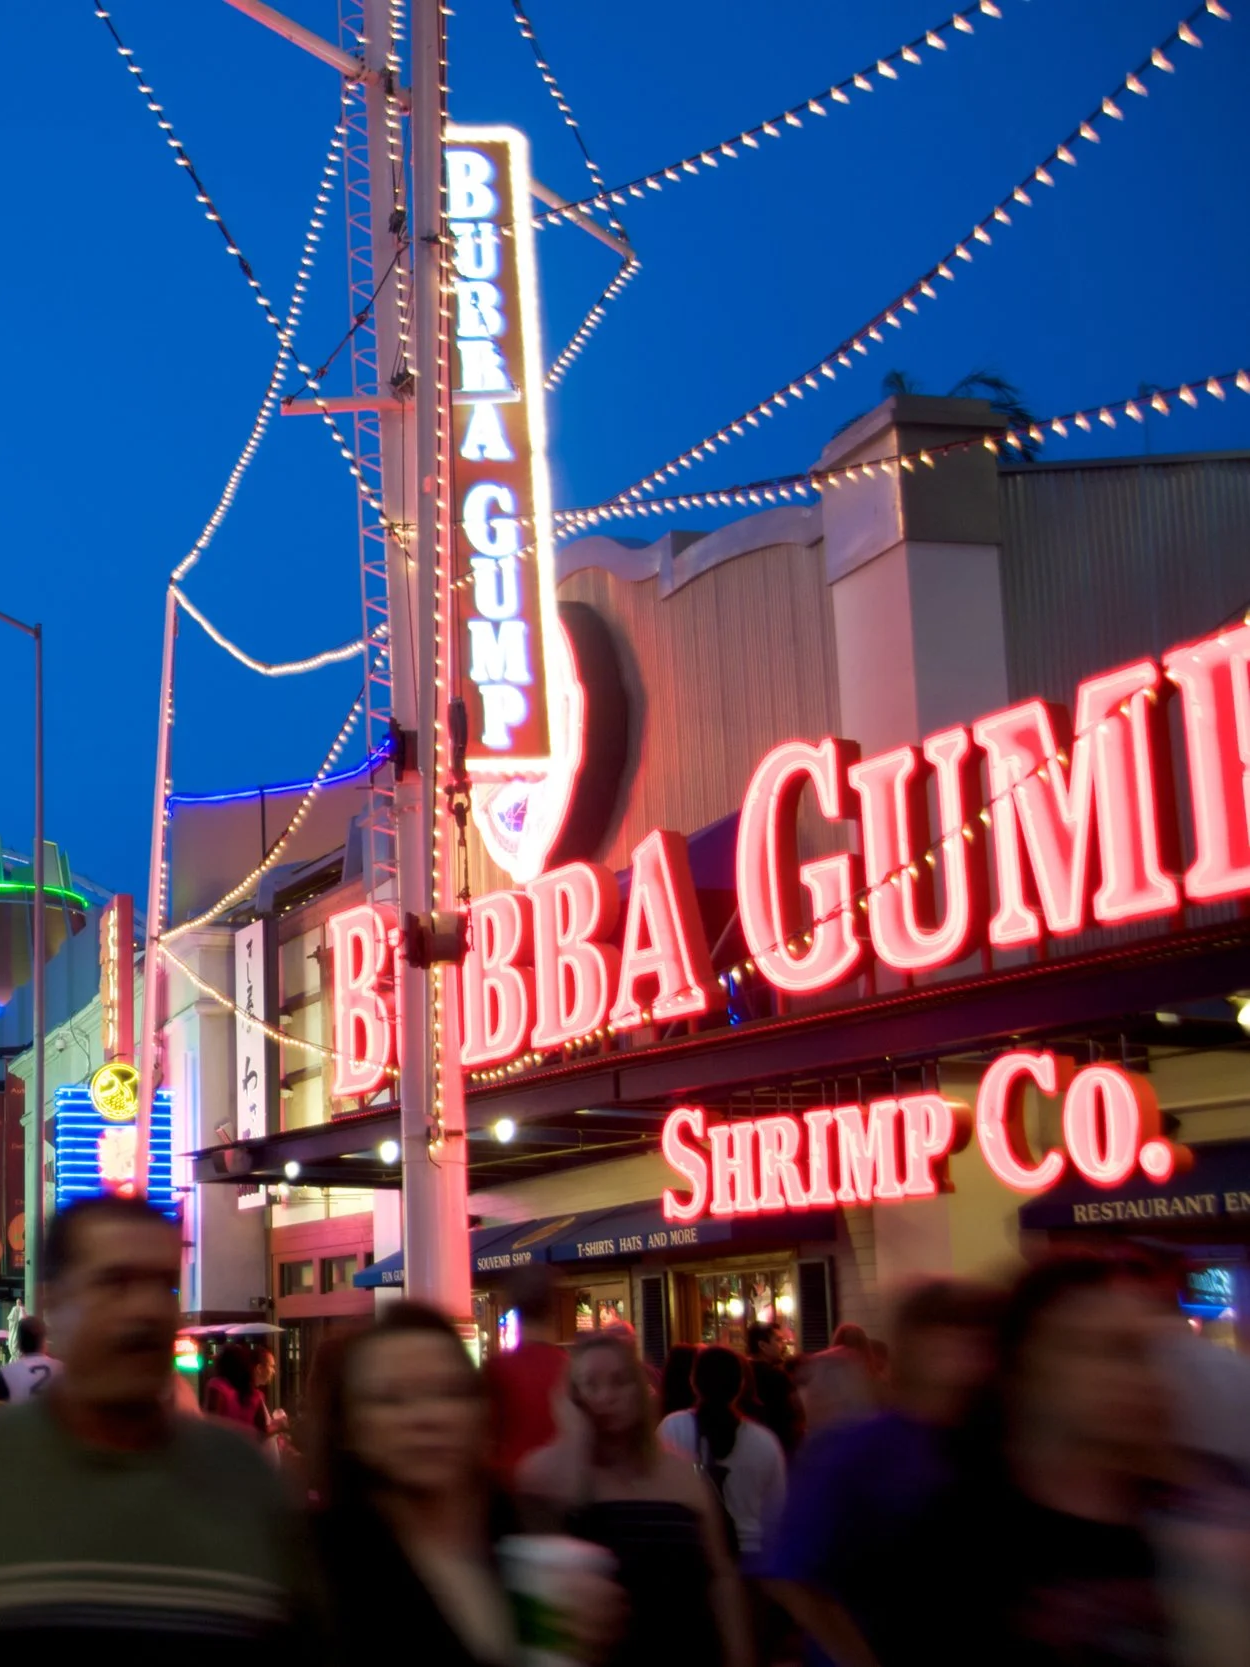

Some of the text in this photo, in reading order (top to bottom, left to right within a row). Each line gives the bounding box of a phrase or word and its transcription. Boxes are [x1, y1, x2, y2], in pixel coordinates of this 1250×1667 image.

[461, 483, 532, 748] GUMP
[328, 828, 707, 1097] BBBA
[661, 1093, 954, 1220] SHRIMP
[577, 1227, 698, 1257] T-SHIRTS HATS AND MORE
[1072, 1193, 1216, 1223] RESTAURANT
[477, 1251, 532, 1271] SOUVENIR SHOP
